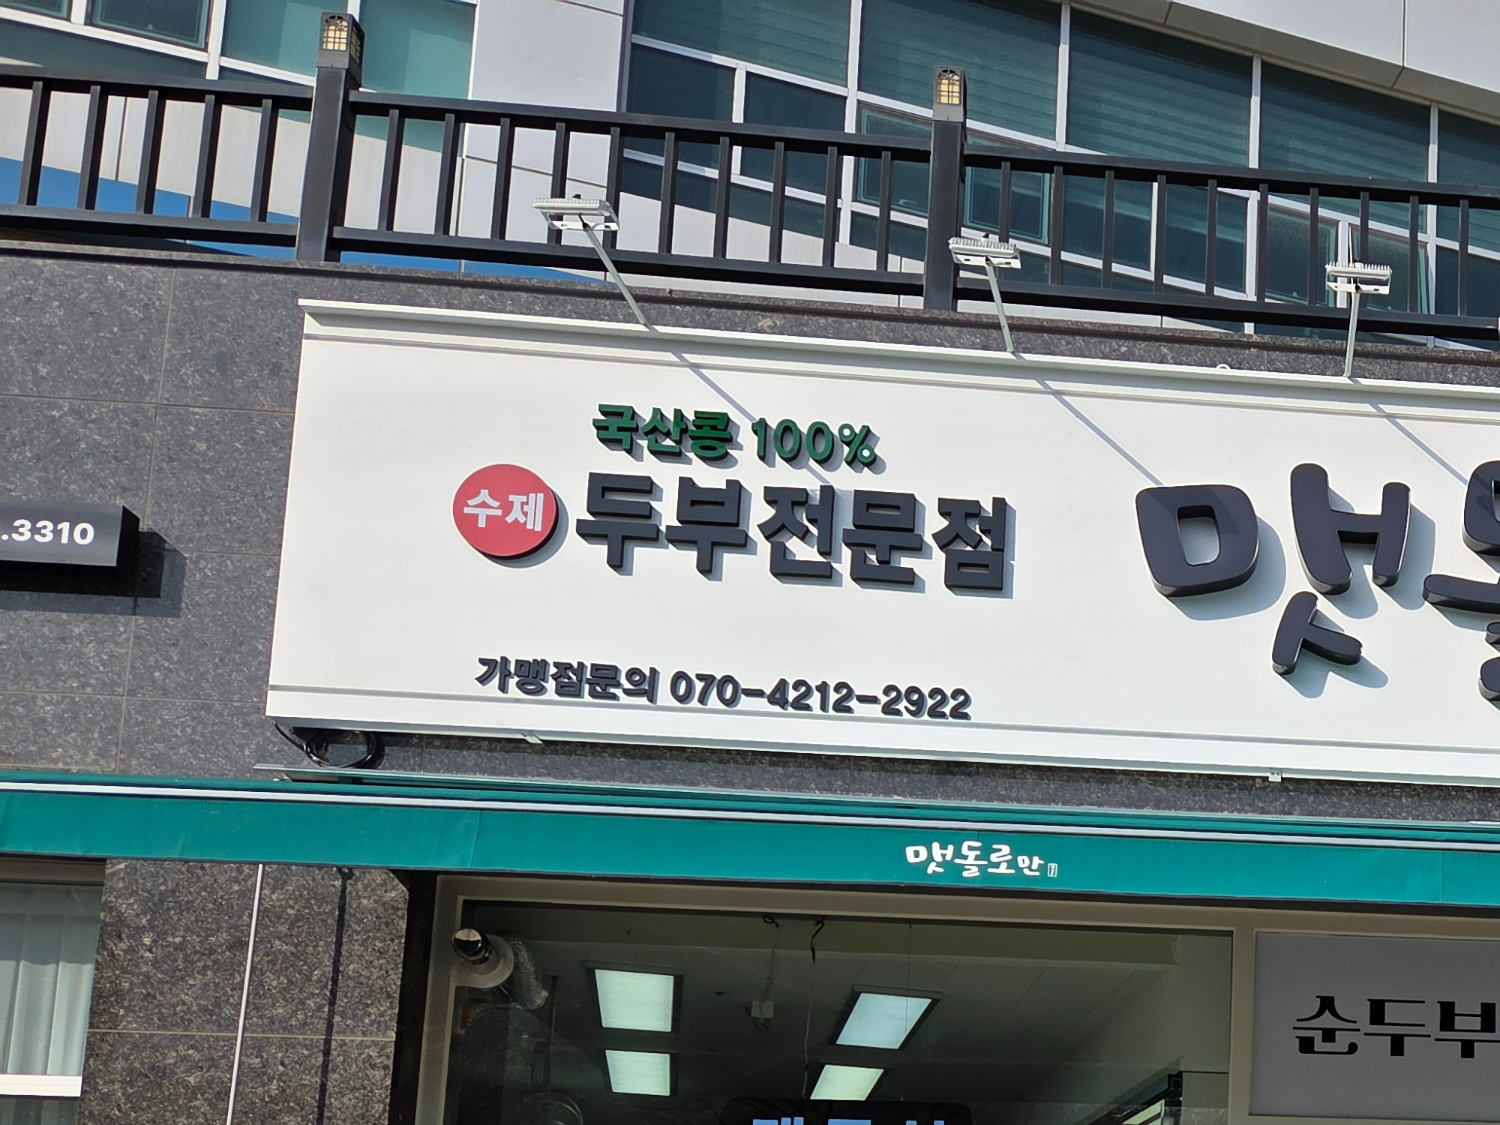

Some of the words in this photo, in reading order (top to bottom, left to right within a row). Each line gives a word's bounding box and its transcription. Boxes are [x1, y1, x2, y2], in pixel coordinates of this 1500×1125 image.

[592, 403, 734, 460] 국산콩
[752, 416, 878, 467] 100%
[463, 488, 545, 532] 수제
[576, 472, 1006, 592] 두부전문점
[475, 655, 661, 704] 가맹점문의
[669, 670, 973, 721] 070-4212-2922
[904, 841, 1045, 878] 맷돌로만
